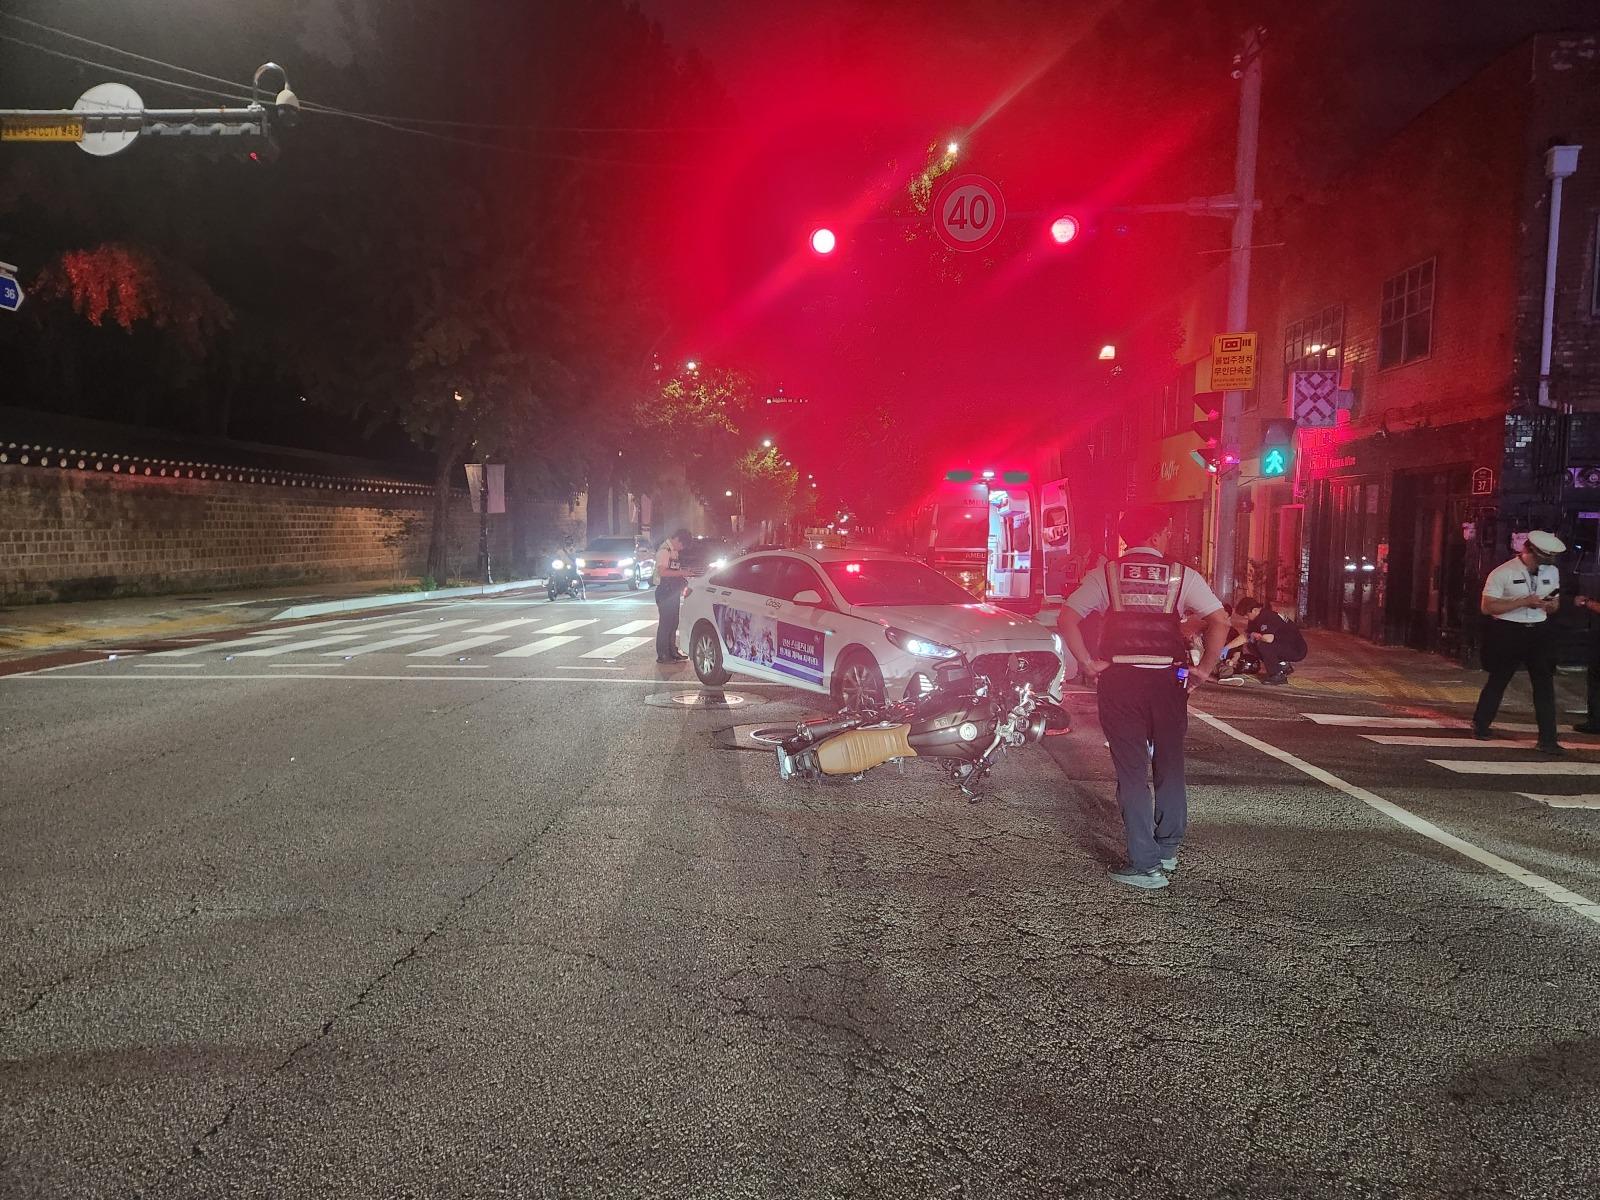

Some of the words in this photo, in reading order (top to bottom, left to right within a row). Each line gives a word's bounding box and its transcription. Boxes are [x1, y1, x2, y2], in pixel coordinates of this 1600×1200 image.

[948, 195, 989, 229] 40
[4, 287, 15, 299] 36
[1215, 355, 1253, 366] 불법주정차
[1214, 365, 1252, 376] 무인단속중
[1477, 480, 1487, 491] 37
